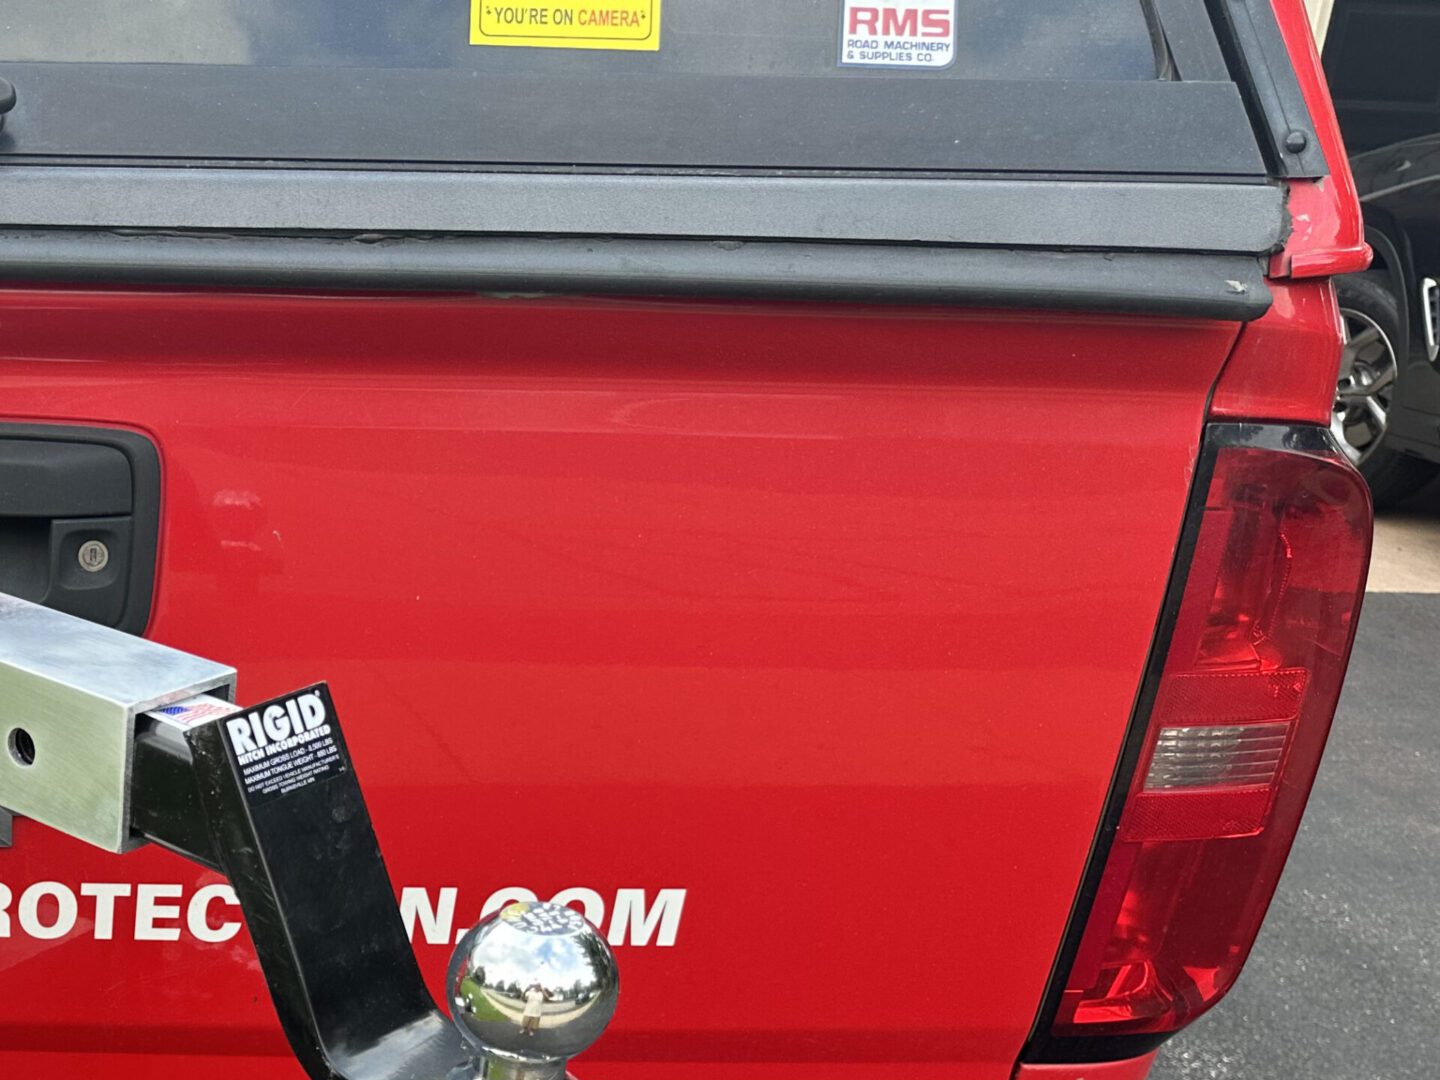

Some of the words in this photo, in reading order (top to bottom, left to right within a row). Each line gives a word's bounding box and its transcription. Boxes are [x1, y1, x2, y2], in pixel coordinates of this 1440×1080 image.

[493, 7, 548, 25] YOU'RE
[552, 8, 574, 26] ON
[577, 9, 640, 27] CAMERA
[848, 6, 951, 38] RMS
[847, 39, 879, 50] ROAD
[883, 40, 951, 52] MACHINERY
[846, 50, 854, 60] &
[859, 51, 913, 62] SUPPLIES
[237, 748, 265, 765] HITCH
[265, 724, 332, 755] INCORPORATED
[289, 747, 306, 757] LOAD
[322, 737, 333, 746] LBS
[326, 745, 338, 754] LBS
